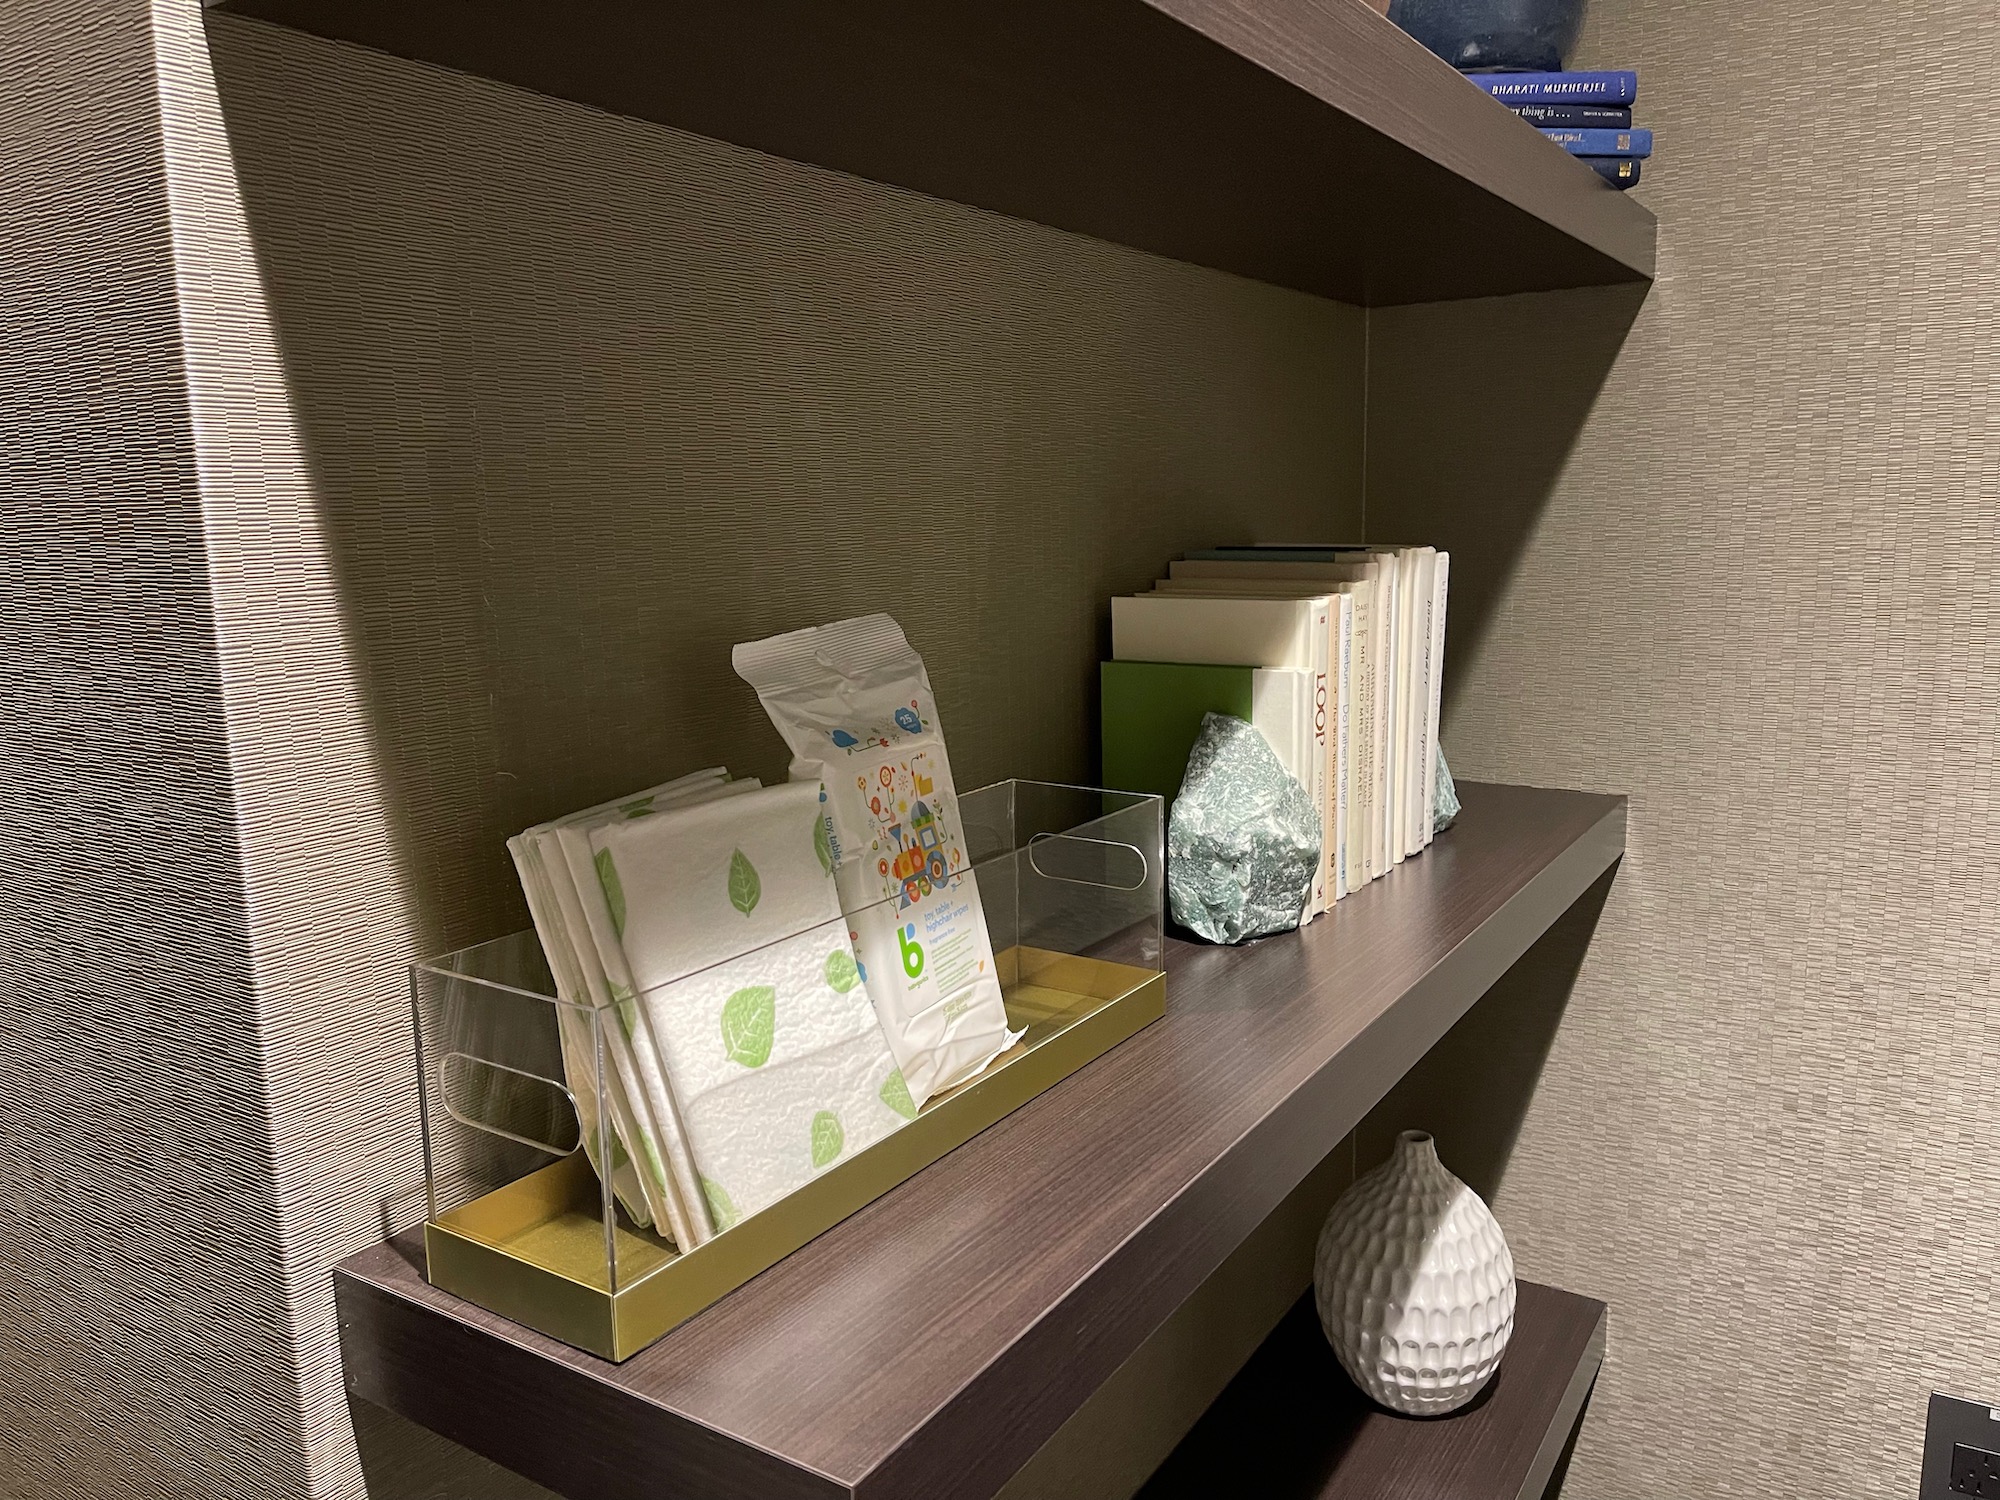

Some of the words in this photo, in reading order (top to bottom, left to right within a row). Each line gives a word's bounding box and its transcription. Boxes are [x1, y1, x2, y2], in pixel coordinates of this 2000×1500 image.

[1491, 84, 1539, 95] BHARATI
[1543, 82, 1607, 94] MUKHERJEE
[1521, 105, 1546, 120] thing
[1343, 639, 1351, 689] Raeburn
[900, 713, 912, 725] 25
[1315, 673, 1326, 746] LOOP
[1342, 703, 1349, 723] Do
[1341, 725, 1349, 767] Fathers
[1340, 768, 1348, 810] Matter?
[825, 816, 834, 835] toy,
[829, 835, 842, 860] table
[924, 911, 935, 922] toy,
[935, 901, 951, 914] table
[925, 911, 954, 933] highchair
